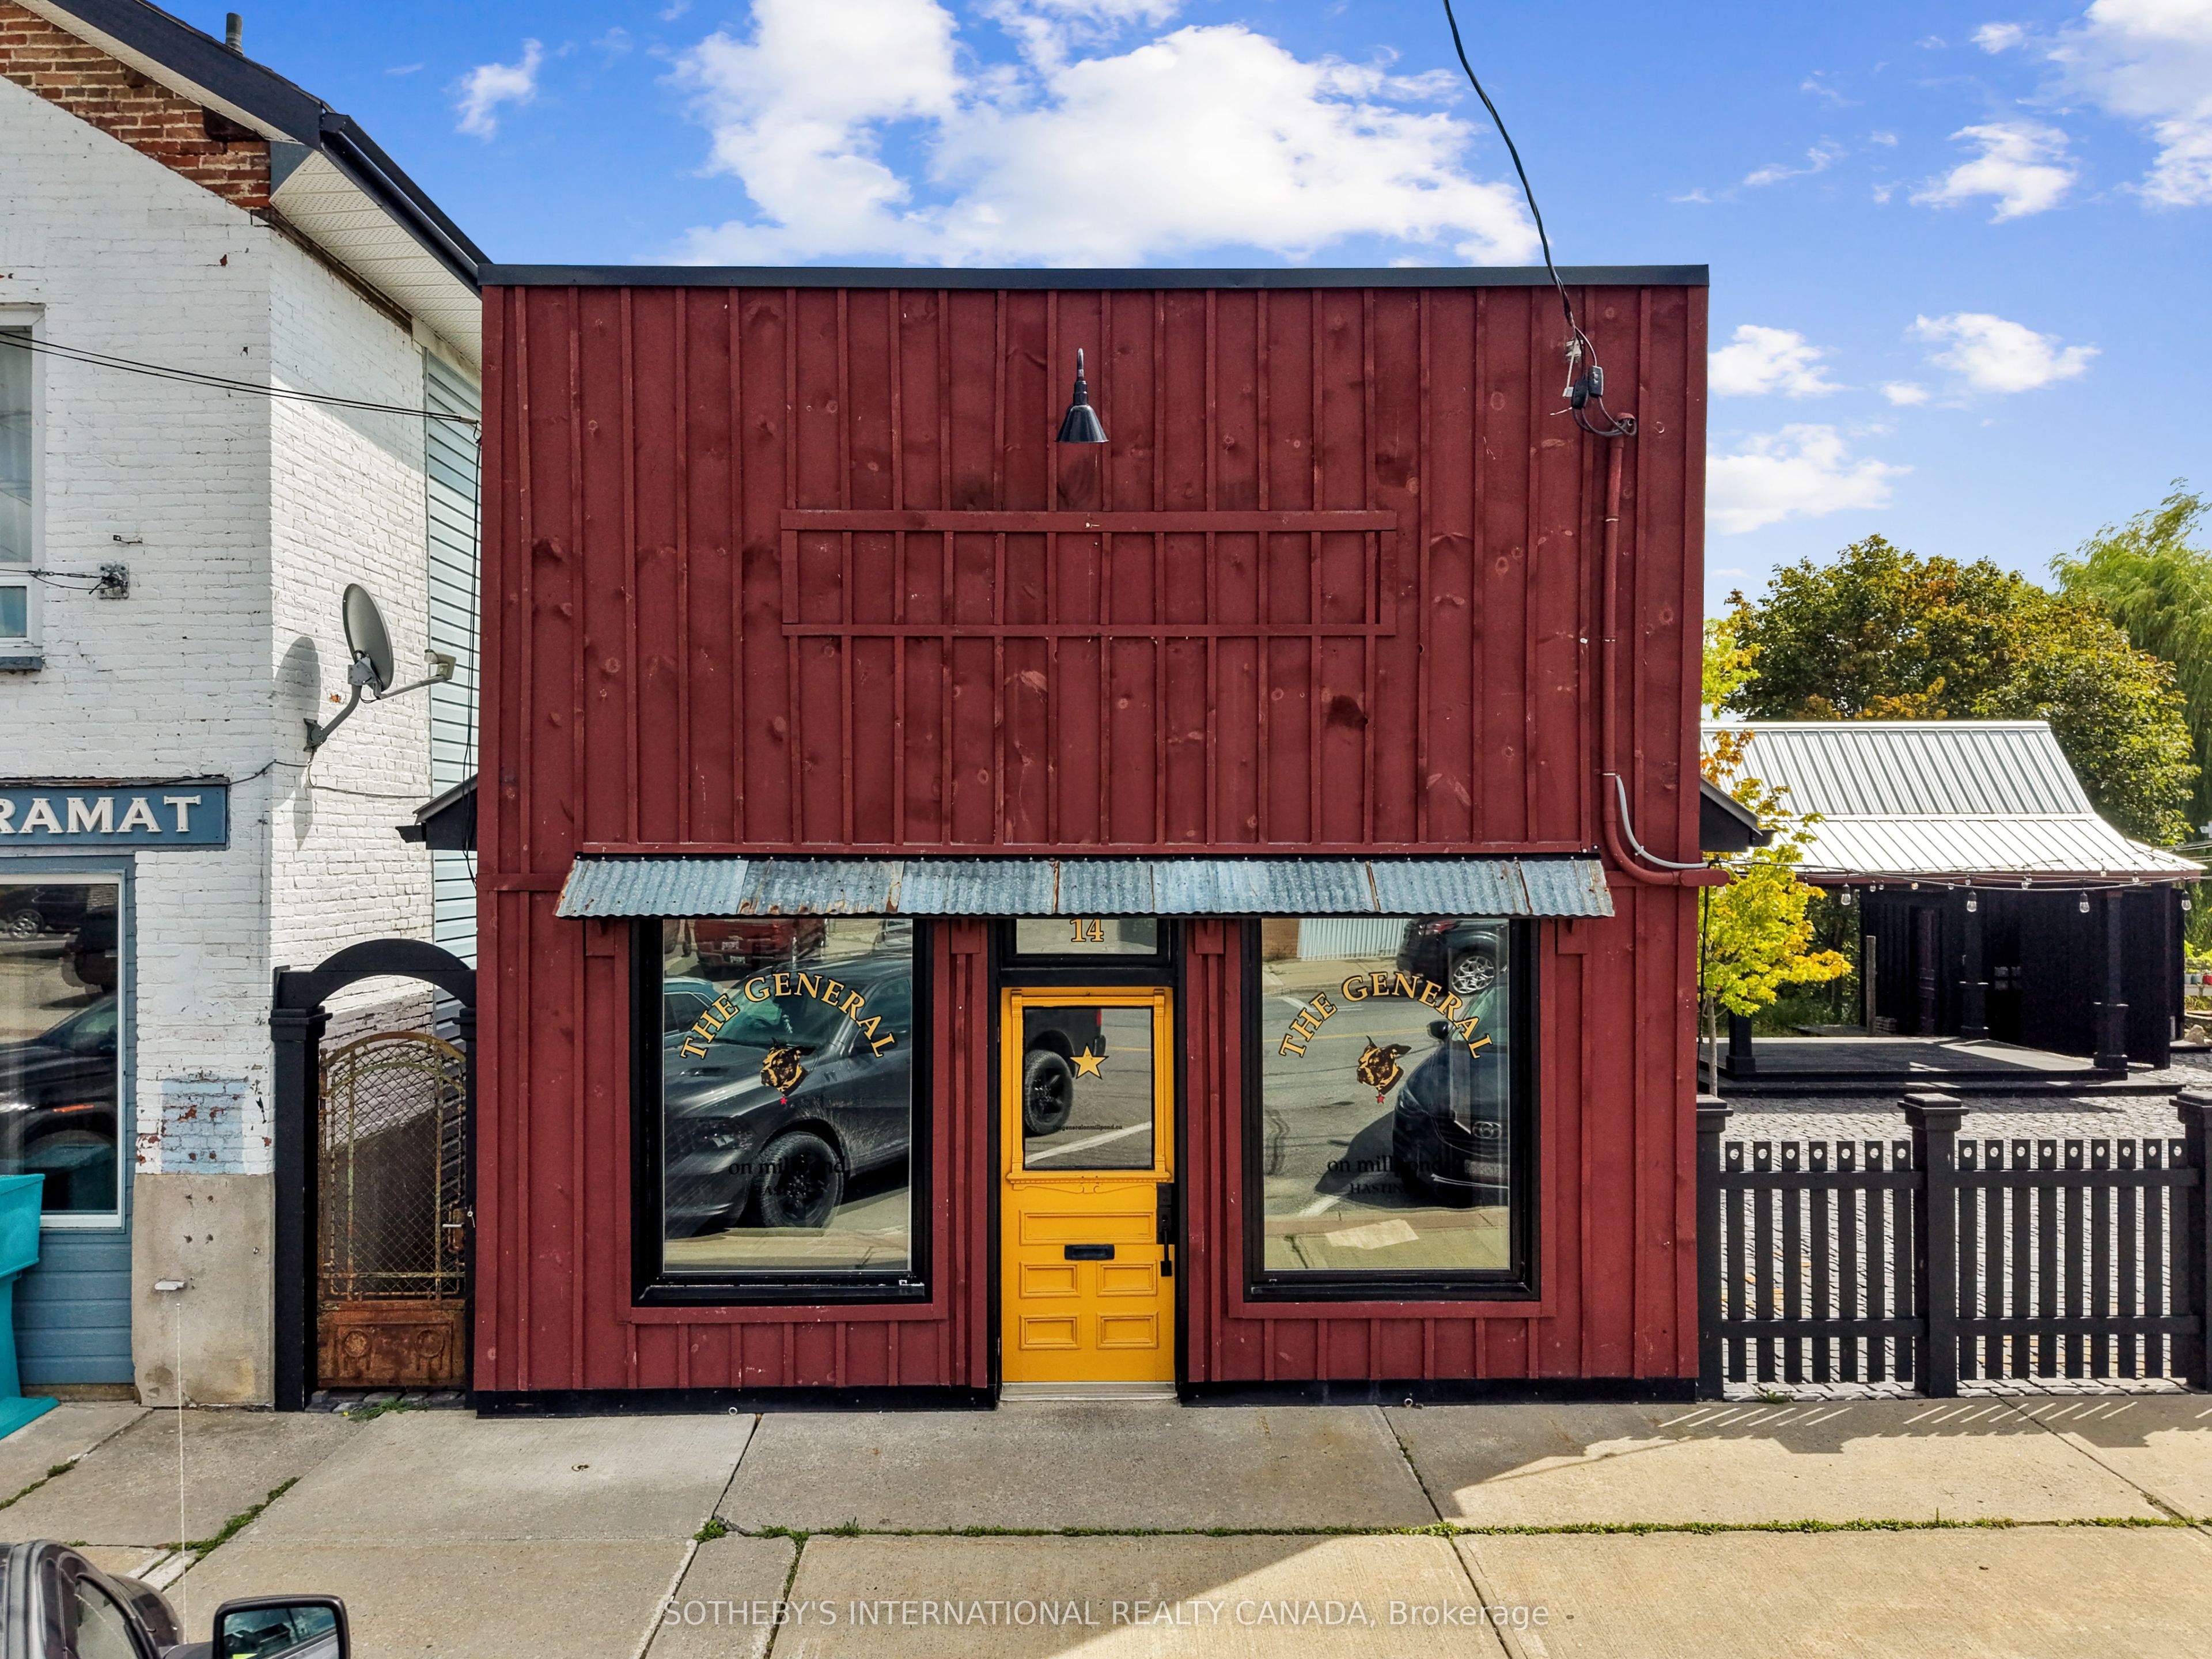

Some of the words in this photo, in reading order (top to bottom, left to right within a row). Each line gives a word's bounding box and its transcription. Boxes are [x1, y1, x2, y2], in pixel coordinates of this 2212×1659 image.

[1070, 919, 1104, 942] 14
[680, 993, 739, 1060] THE
[744, 971, 896, 1059] GENERAL
[1279, 992, 1338, 1059] THE
[1342, 971, 1494, 1060] GENERAL
[728, 1162, 752, 1175] on
[1328, 1159, 1351, 1172] on
[1357, 1154, 1443, 1177] millond
[1350, 1182, 1416, 1194] HASTIN
